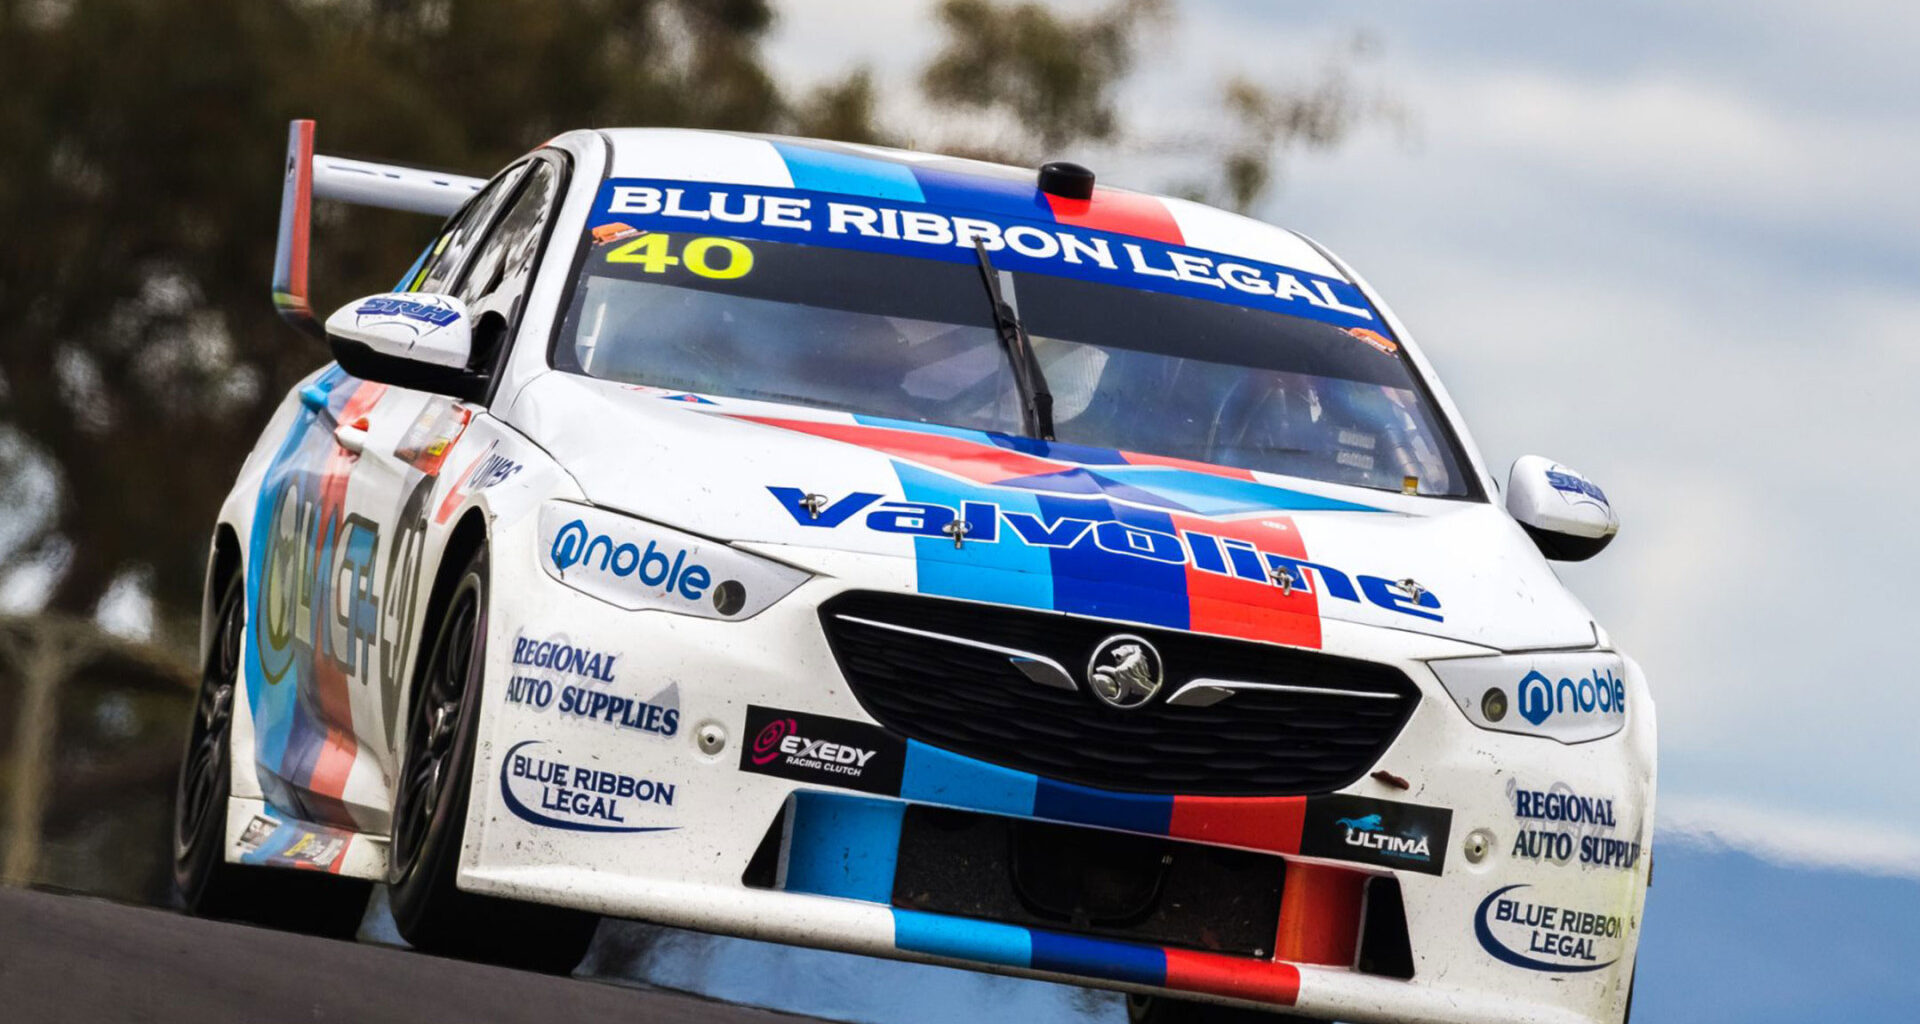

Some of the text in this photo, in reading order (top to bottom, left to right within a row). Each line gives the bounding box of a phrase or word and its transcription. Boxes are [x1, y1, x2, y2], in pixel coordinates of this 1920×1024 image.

[606, 233, 754, 279] 40
[608, 186, 1373, 320] BLUE RIBBON LEGAL
[582, 534, 711, 600] noble
[766, 485, 1444, 623] Valvoline
[513, 636, 616, 682] REGIONAL
[504, 675, 680, 737] AUTO SUPPLIES
[1557, 668, 1625, 714] noble
[780, 735, 877, 767] EXEDY
[786, 756, 862, 777] RACING CLUTCH
[513, 755, 676, 806] BLUE RIBBON
[541, 787, 624, 823] LEGAL
[1515, 789, 1616, 827] REGIONAL
[1345, 828, 1430, 856] ULTIMA
[1511, 829, 1572, 861] AUTO
[1495, 898, 1557, 930] BLUE
[1530, 931, 1596, 961] LEGAL
